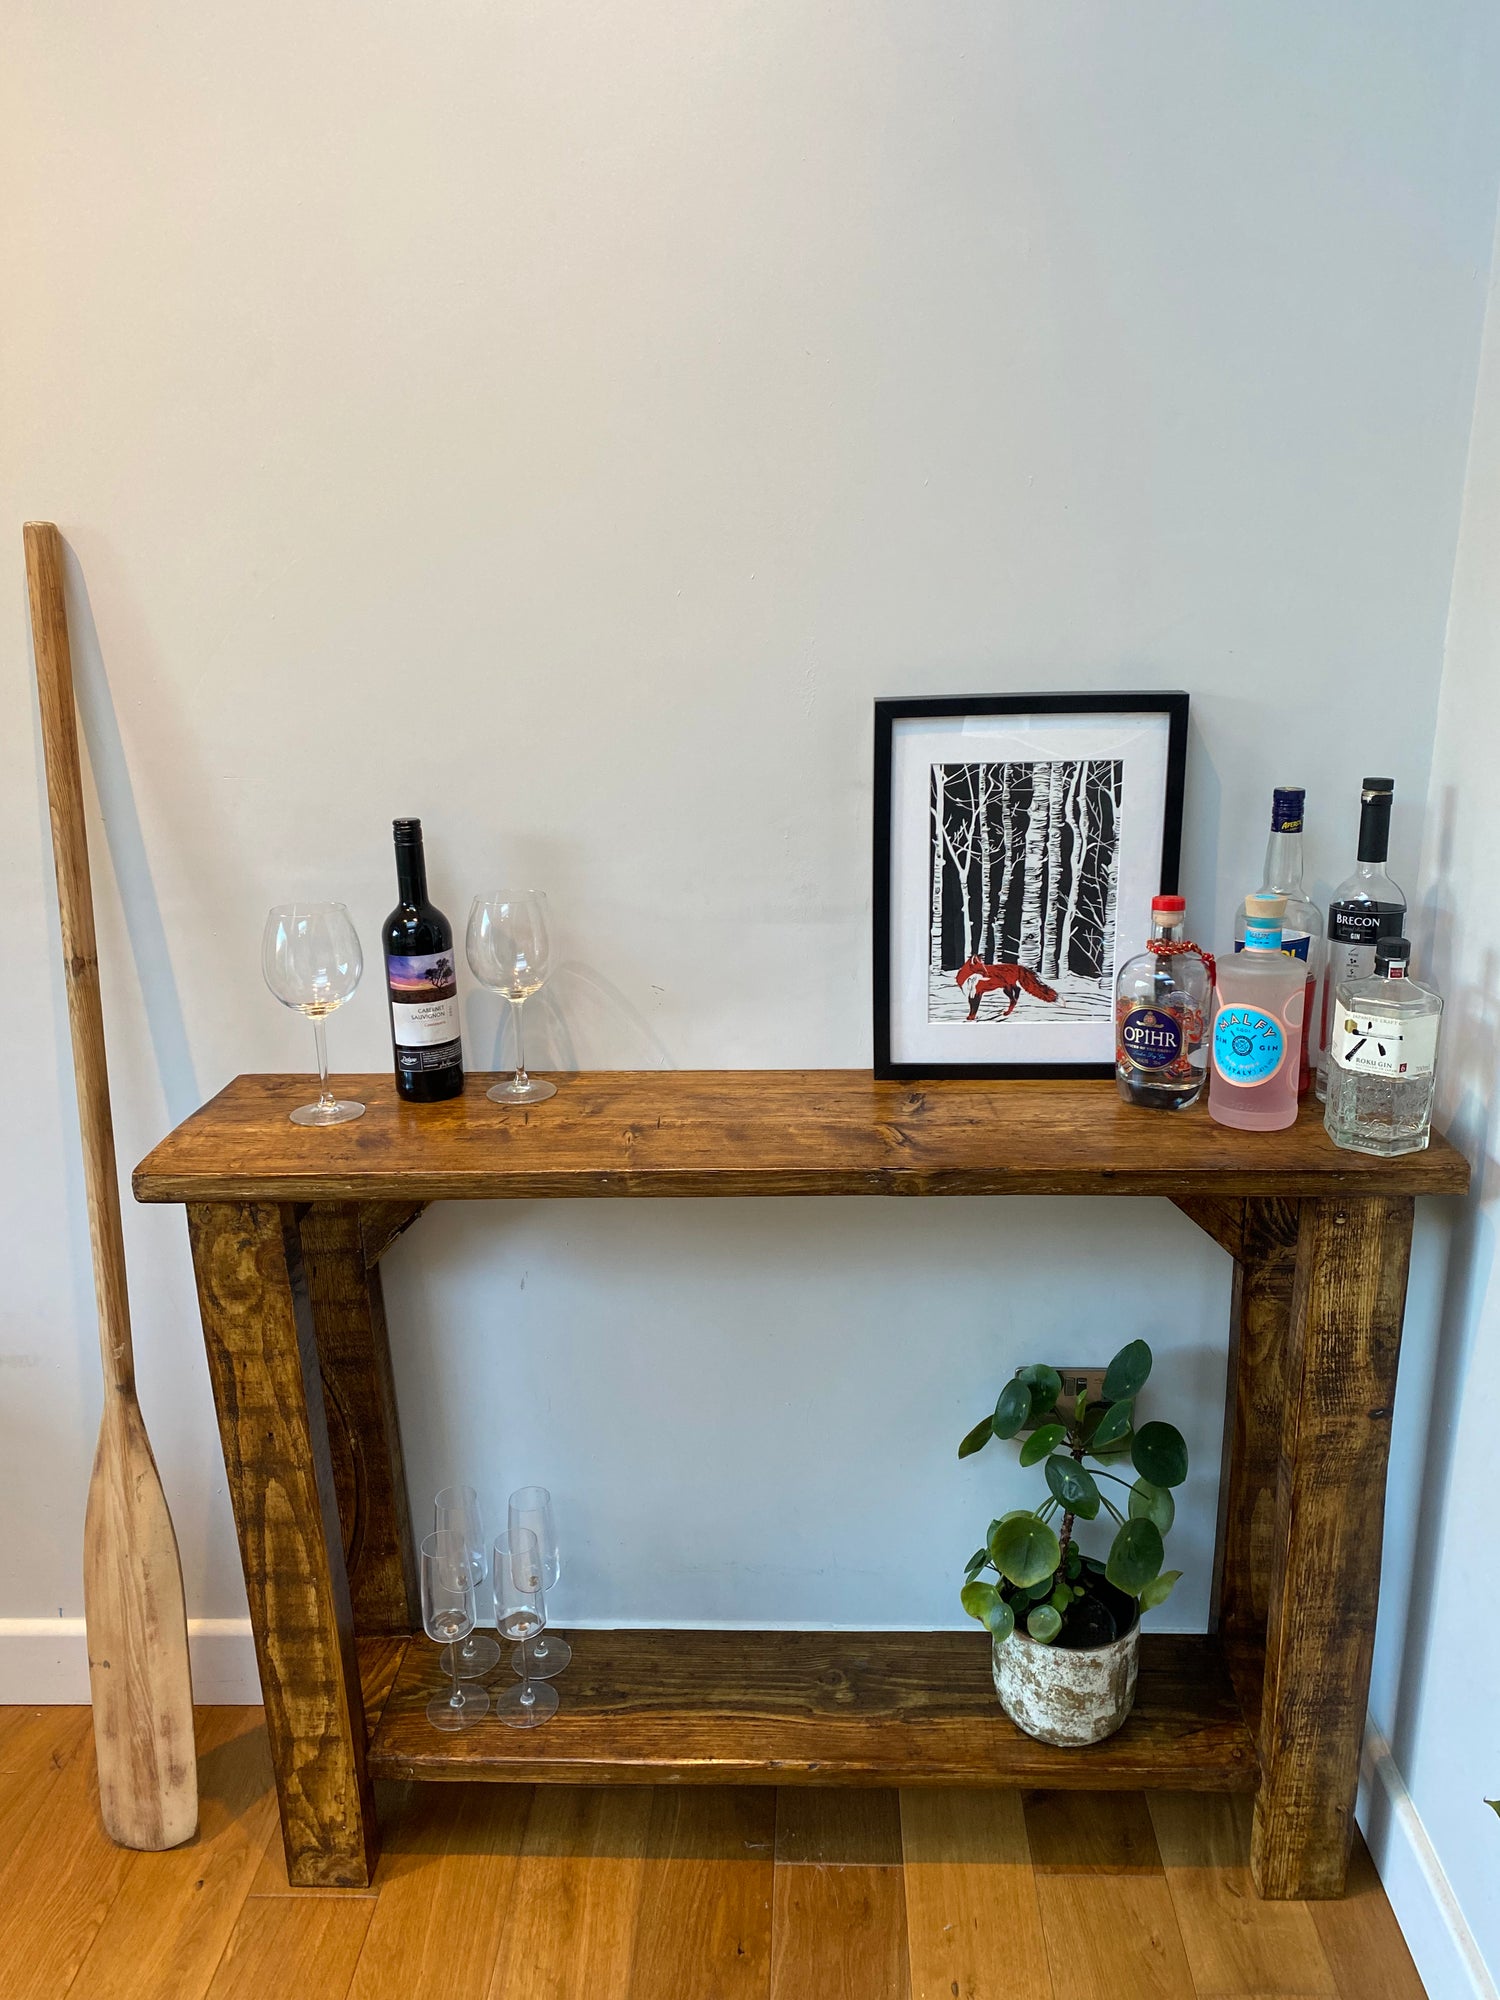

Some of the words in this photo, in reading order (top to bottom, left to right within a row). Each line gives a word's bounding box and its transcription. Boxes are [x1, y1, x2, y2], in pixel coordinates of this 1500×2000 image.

[1336, 913, 1380, 927] BRECON
[418, 1005, 445, 1014] CABERNET
[411, 1011, 445, 1020] SAUVIGNON
[1219, 1013, 1276, 1038] MALFY
[1124, 1026, 1177, 1048] OPIHR
[1216, 1035, 1227, 1044] GIN
[1356, 1057, 1377, 1066] ROKU
[1378, 1061, 1393, 1069] GIN
[1400, 1064, 1406, 1072] 6
